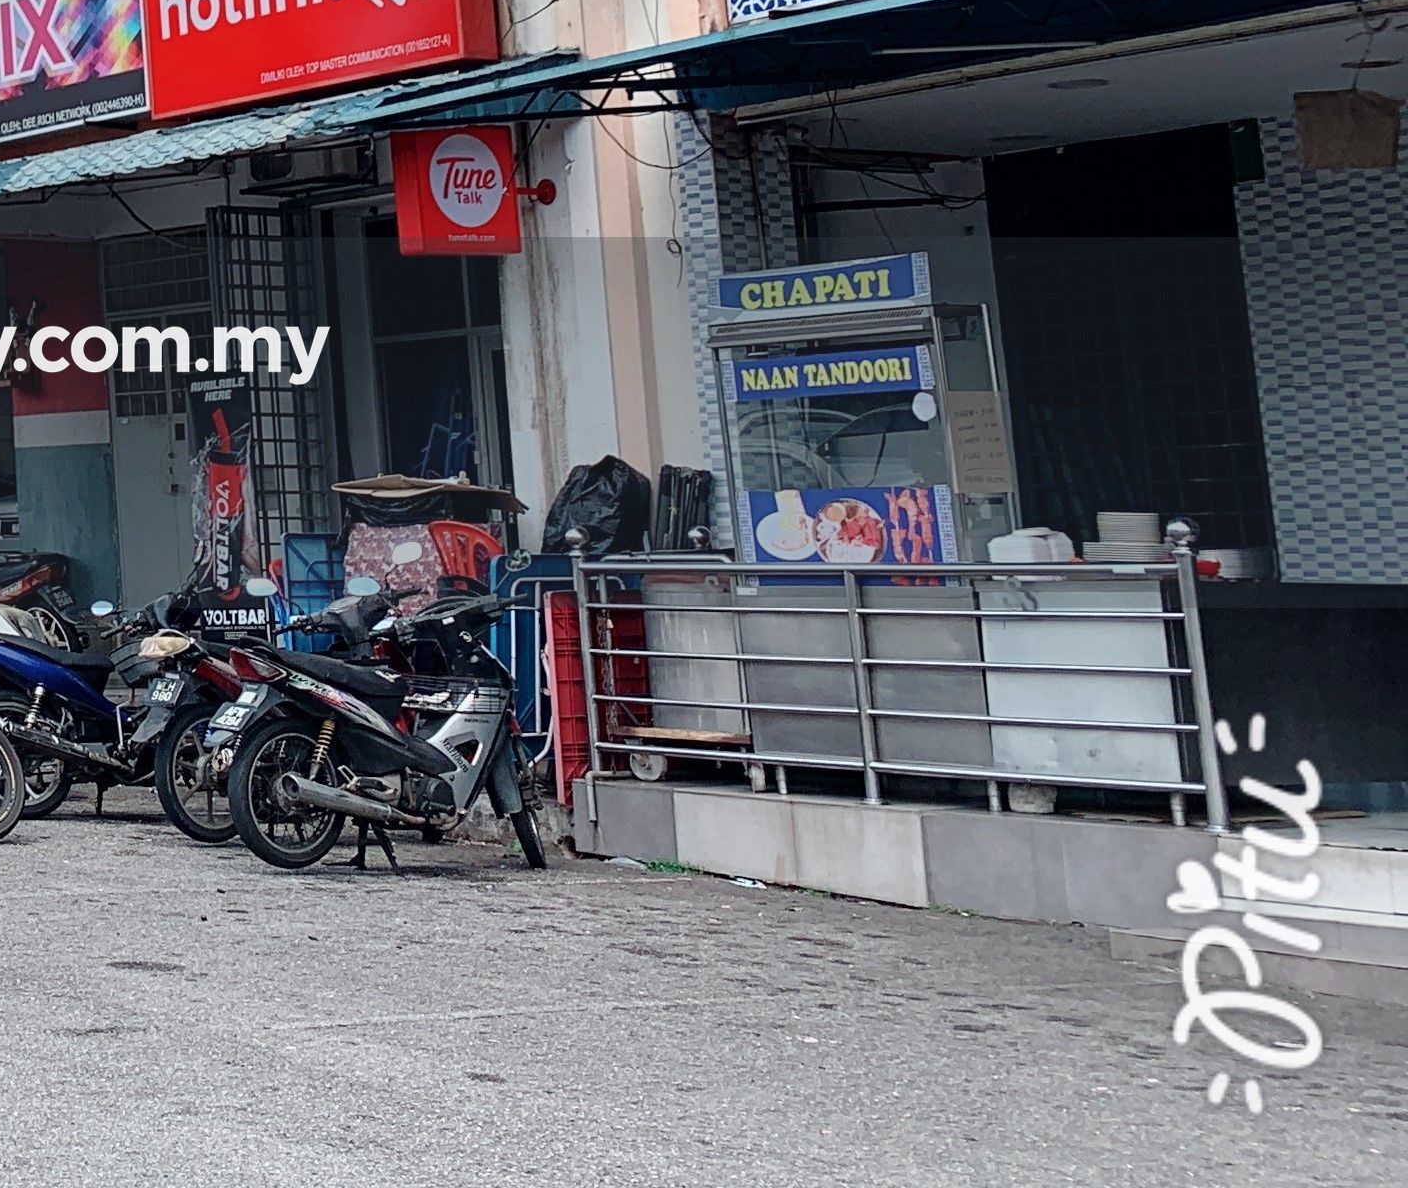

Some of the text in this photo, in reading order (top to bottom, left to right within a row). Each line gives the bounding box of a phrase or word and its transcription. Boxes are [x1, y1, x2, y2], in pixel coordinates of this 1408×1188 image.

[306, 62, 319, 75] TOP
[320, 55, 347, 71] MASTER
[55, 103, 92, 123] NETWORK
[436, 156, 497, 200] Tune
[455, 191, 483, 205] Talk
[740, 269, 892, 310] CHAPATI
[741, 356, 913, 392] NAAN TANDOORI
[190, 376, 246, 393] AVAILABLE
[205, 389, 232, 403] HERE
[203, 608, 266, 626] VOLTBAR
